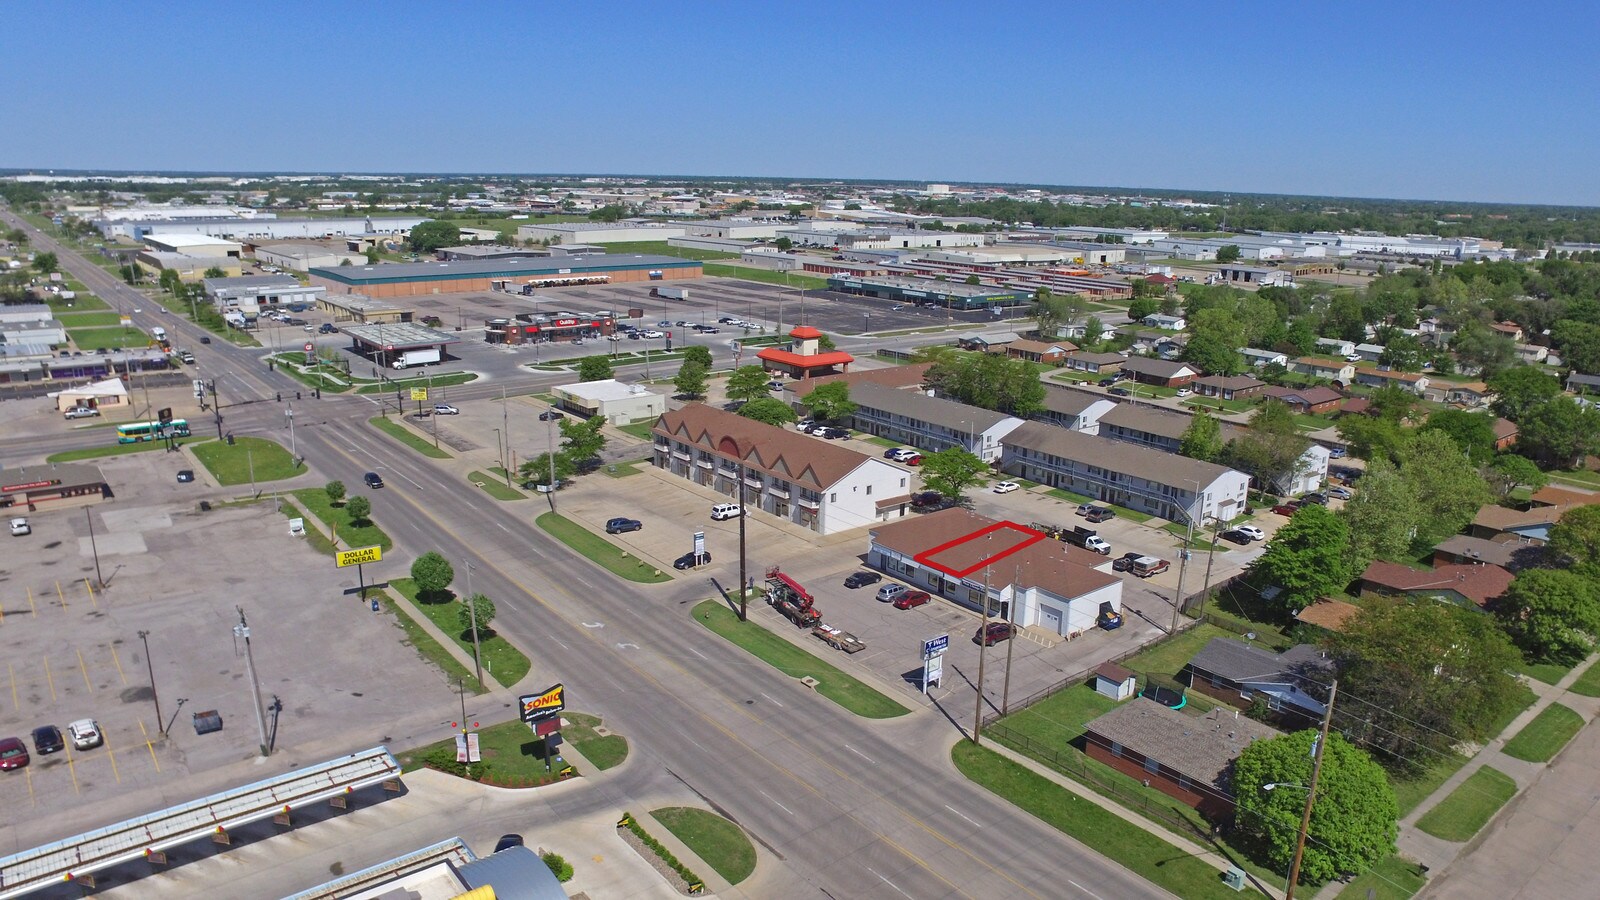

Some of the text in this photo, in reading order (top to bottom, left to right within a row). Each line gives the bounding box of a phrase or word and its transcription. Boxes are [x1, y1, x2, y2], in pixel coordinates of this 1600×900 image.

[344, 549, 374, 558] DOLLAR
[342, 556, 376, 565] GENERAL
[933, 637, 947, 647] West
[526, 692, 560, 710] SONIC
